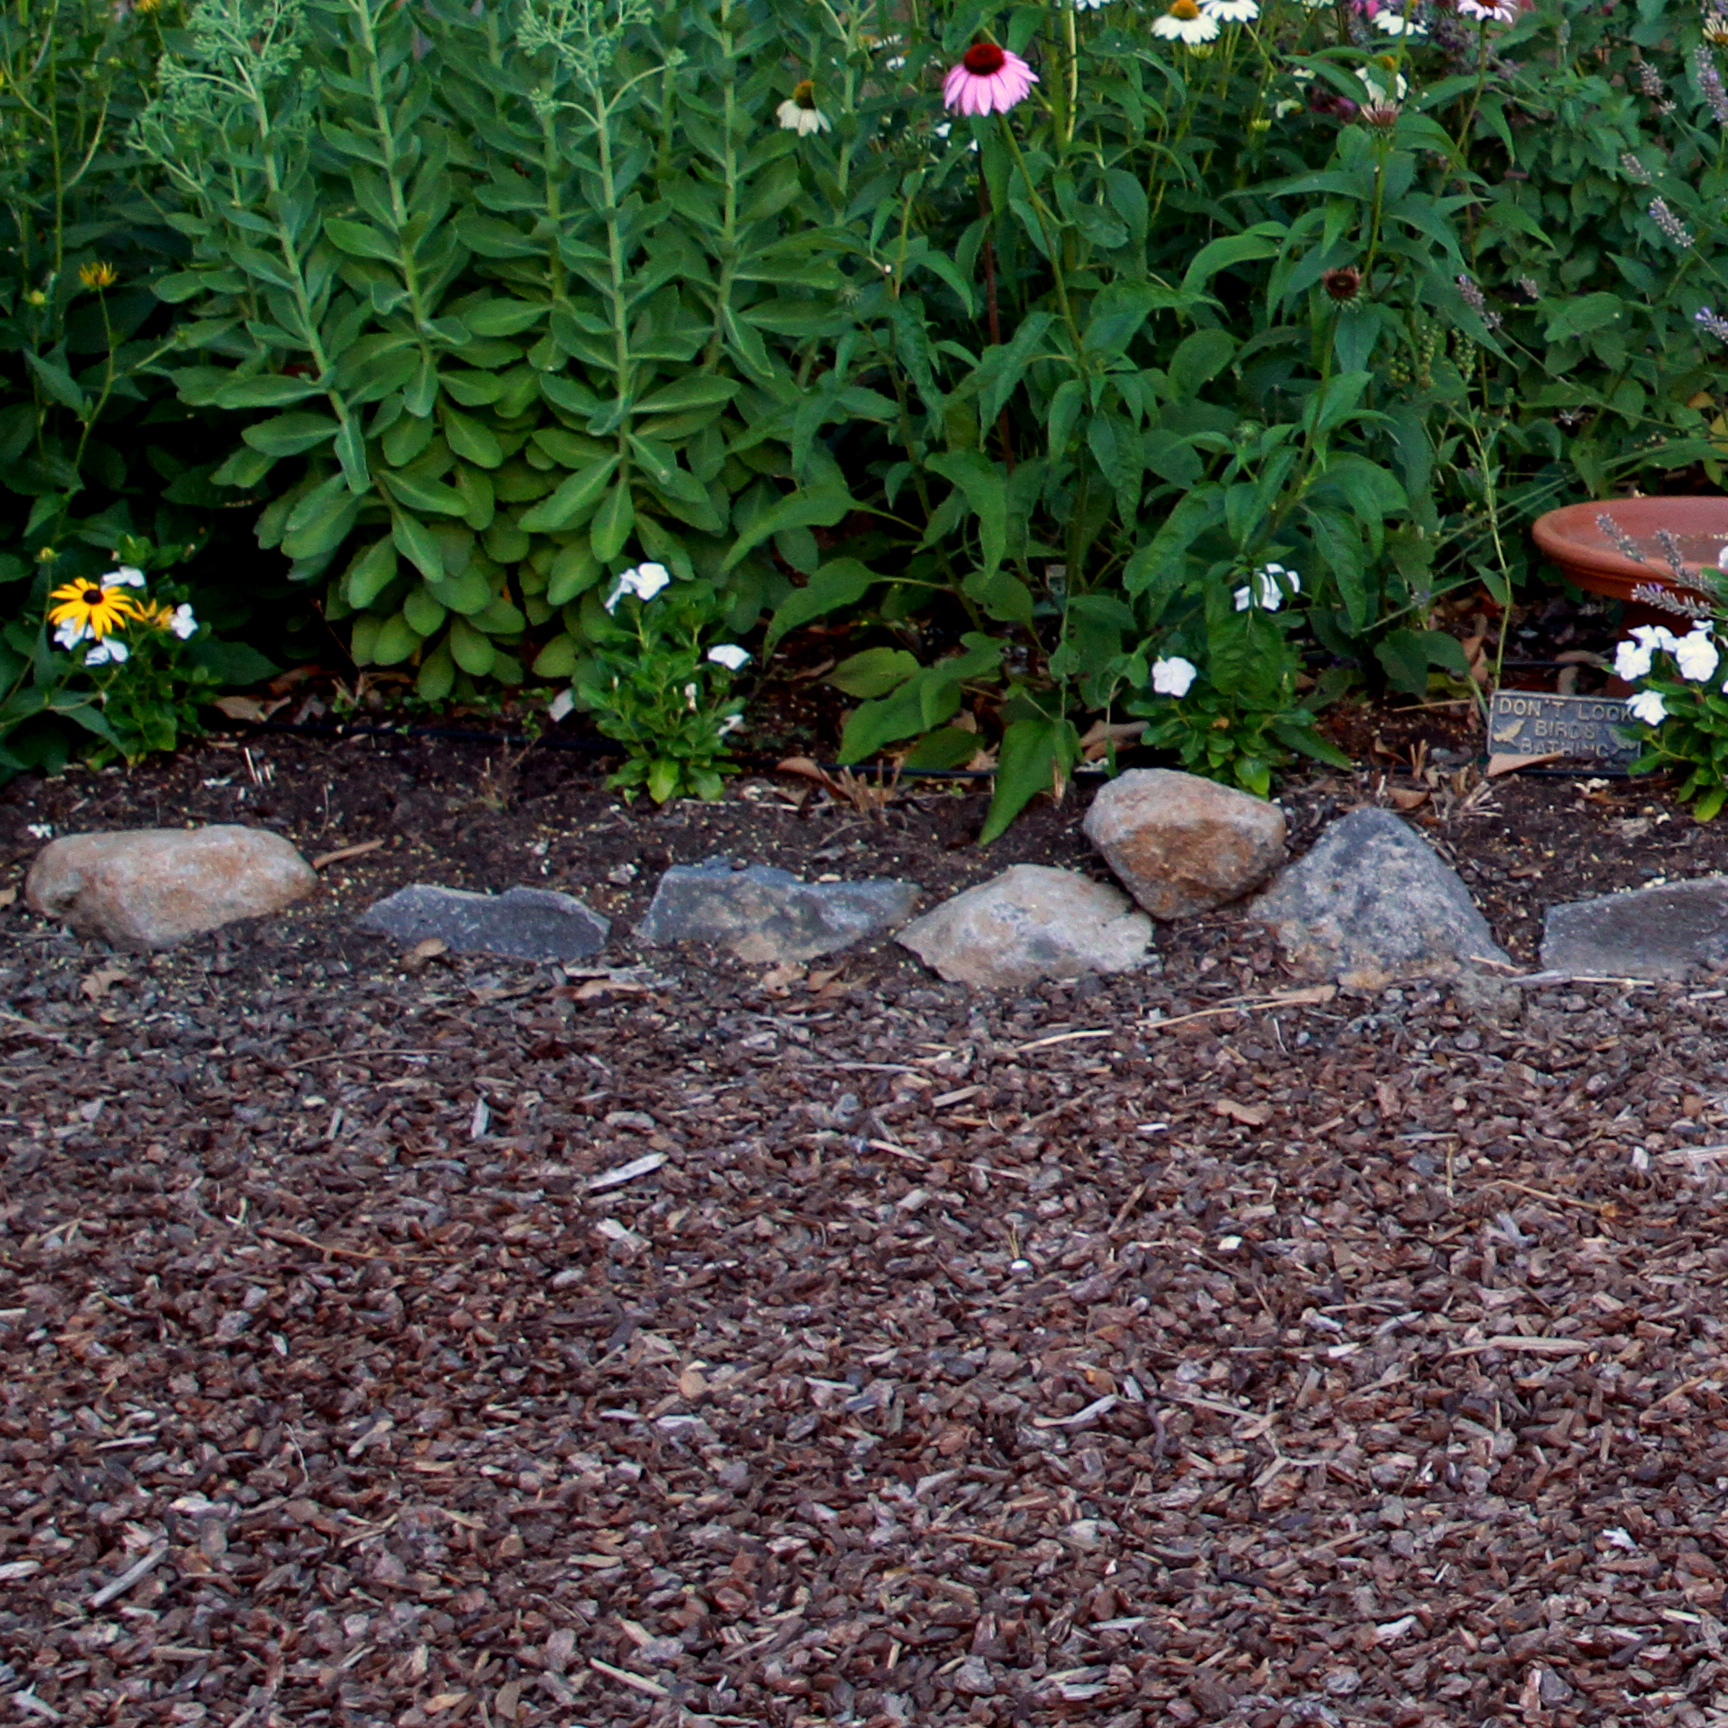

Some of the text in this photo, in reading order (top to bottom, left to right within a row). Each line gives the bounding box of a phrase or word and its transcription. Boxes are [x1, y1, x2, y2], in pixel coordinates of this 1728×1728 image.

[1499, 697, 1634, 722] DON'T LOOK
[1535, 720, 1596, 741] BIRDS
